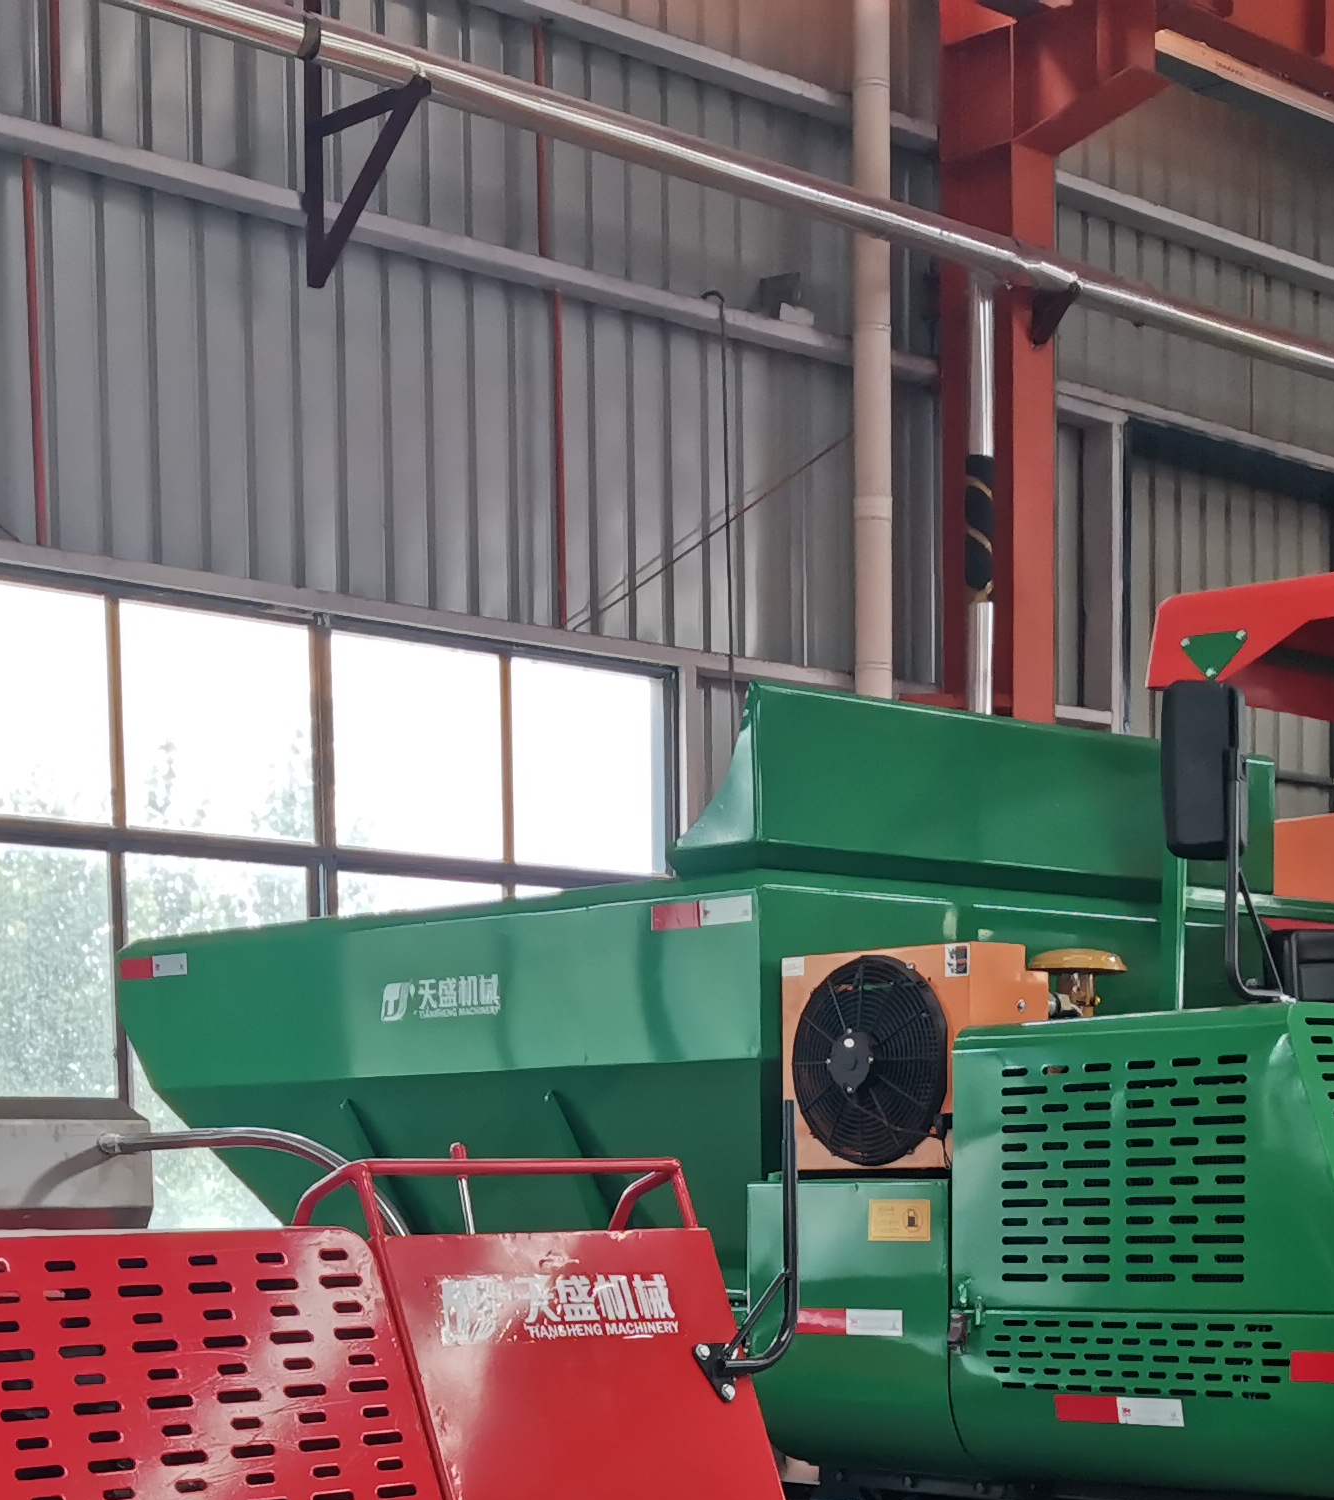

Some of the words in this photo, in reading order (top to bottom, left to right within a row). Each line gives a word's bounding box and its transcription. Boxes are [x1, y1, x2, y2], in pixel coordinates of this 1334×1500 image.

[418, 974, 500, 1010] 天盛机械
[514, 1273, 676, 1323] 天盛机械
[526, 1322, 603, 1340] TIANSHENG
[604, 1321, 679, 1336] MACHINERY
